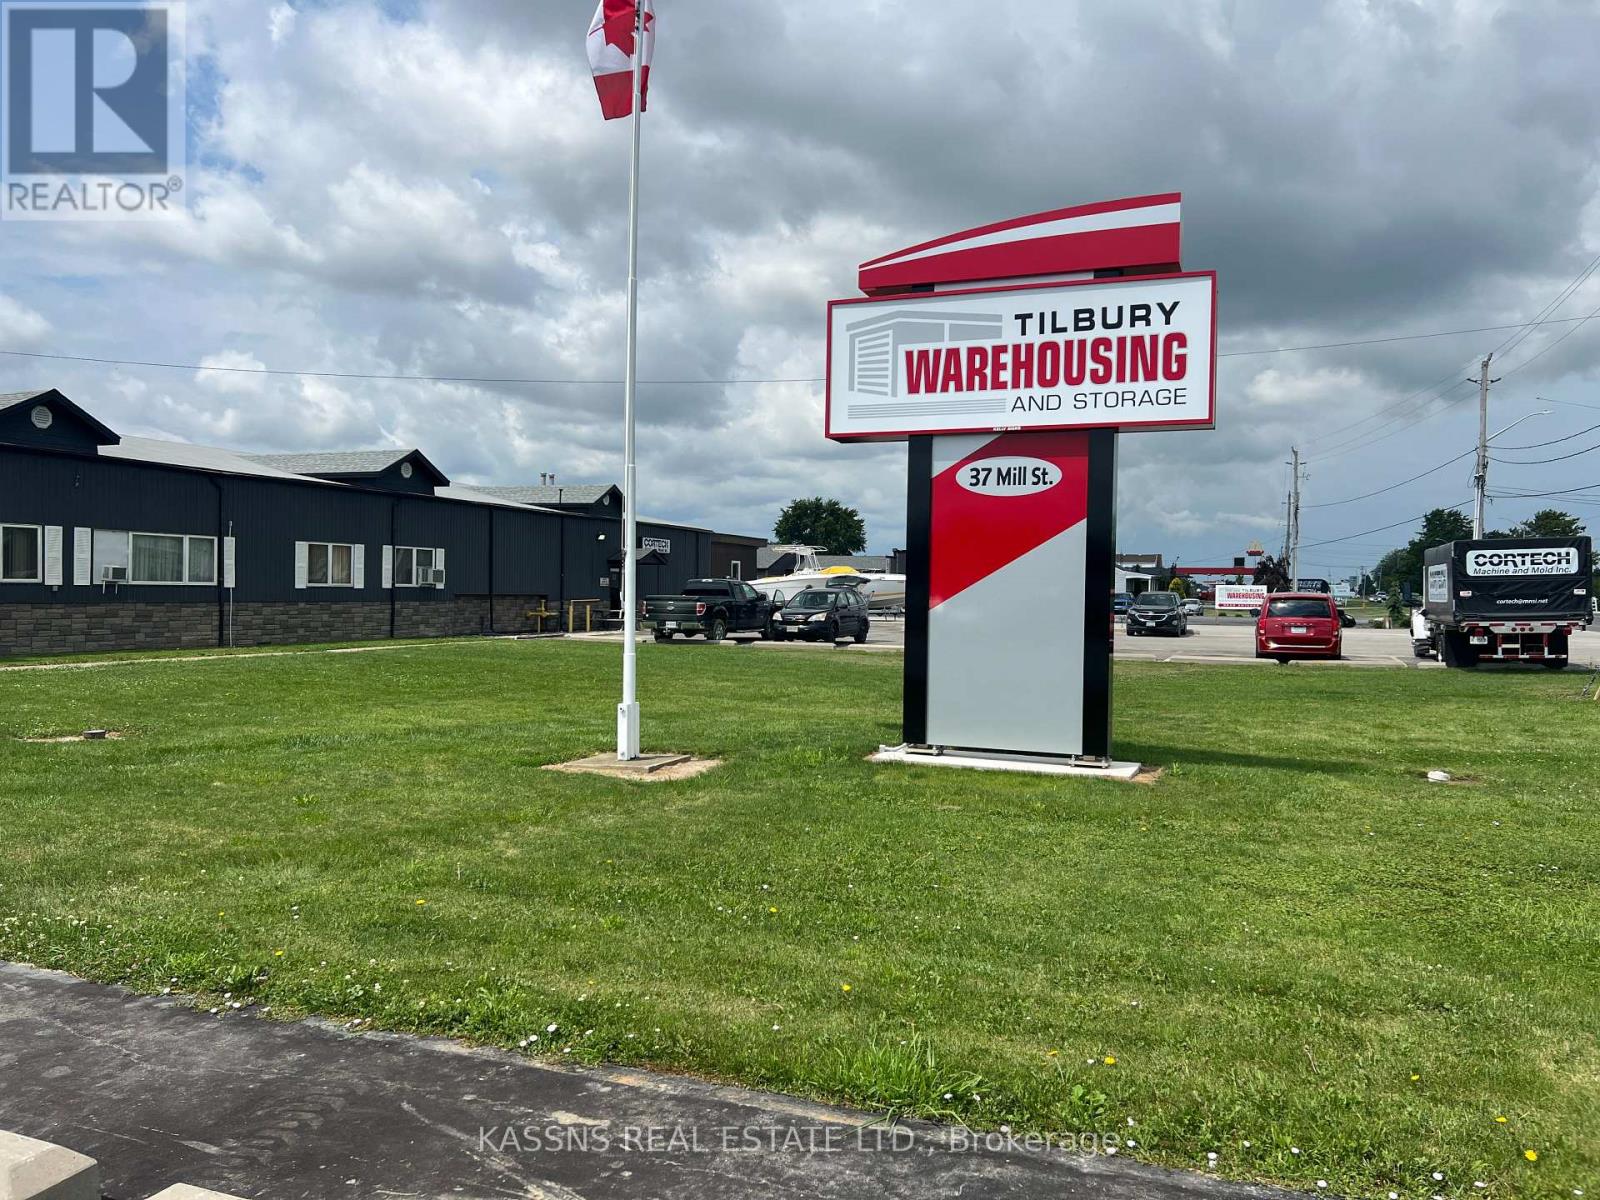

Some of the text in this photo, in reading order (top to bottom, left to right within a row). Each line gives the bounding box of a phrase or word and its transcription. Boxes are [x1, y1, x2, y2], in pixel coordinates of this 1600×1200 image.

[1014, 301, 1181, 337] TILBURY
[905, 332, 1188, 395] WAREHOUSING
[1010, 387, 1188, 413] AND STORAGE
[969, 465, 1054, 487] 37 Mill St.
[1473, 552, 1571, 568] CORTECH
[1473, 565, 1572, 575] Machine and Mold Inc.
[1226, 592, 1265, 600] WAREHOUSING
